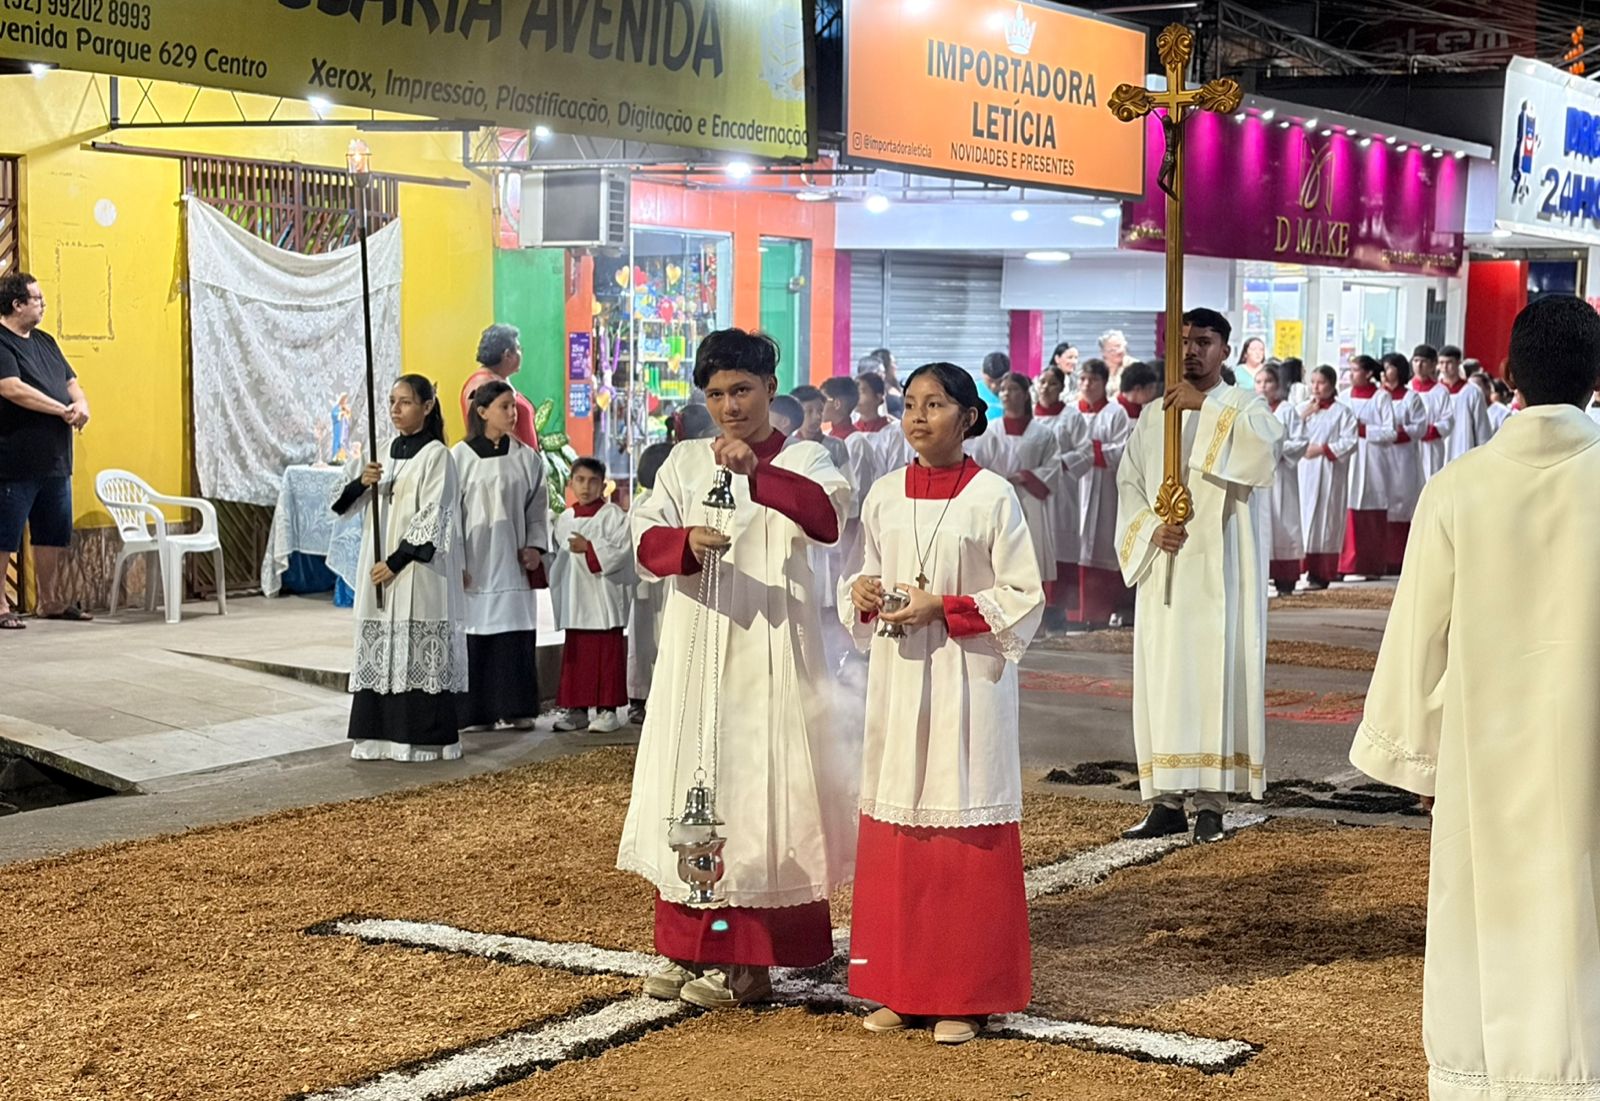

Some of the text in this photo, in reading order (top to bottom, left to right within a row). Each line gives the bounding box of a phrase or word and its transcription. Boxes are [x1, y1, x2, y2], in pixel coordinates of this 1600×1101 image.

[108, 0, 151, 31] 8993
[519, 0, 723, 78] AVENIDA
[76, 27, 152, 63] Parque
[159, 41, 197, 68] 629
[204, 48, 268, 78] Centro
[927, 38, 1097, 107] IMPORTADORA
[308, 57, 809, 149] Xerox, Impressão, Plastificação, Digitação e Encadernação
[972, 98, 1057, 150] LETÍCIA
[950, 142, 1075, 176] NOVIDADES E PRESENTES
[1274, 215, 1291, 252] D
[1295, 216, 1350, 258] MAKE
